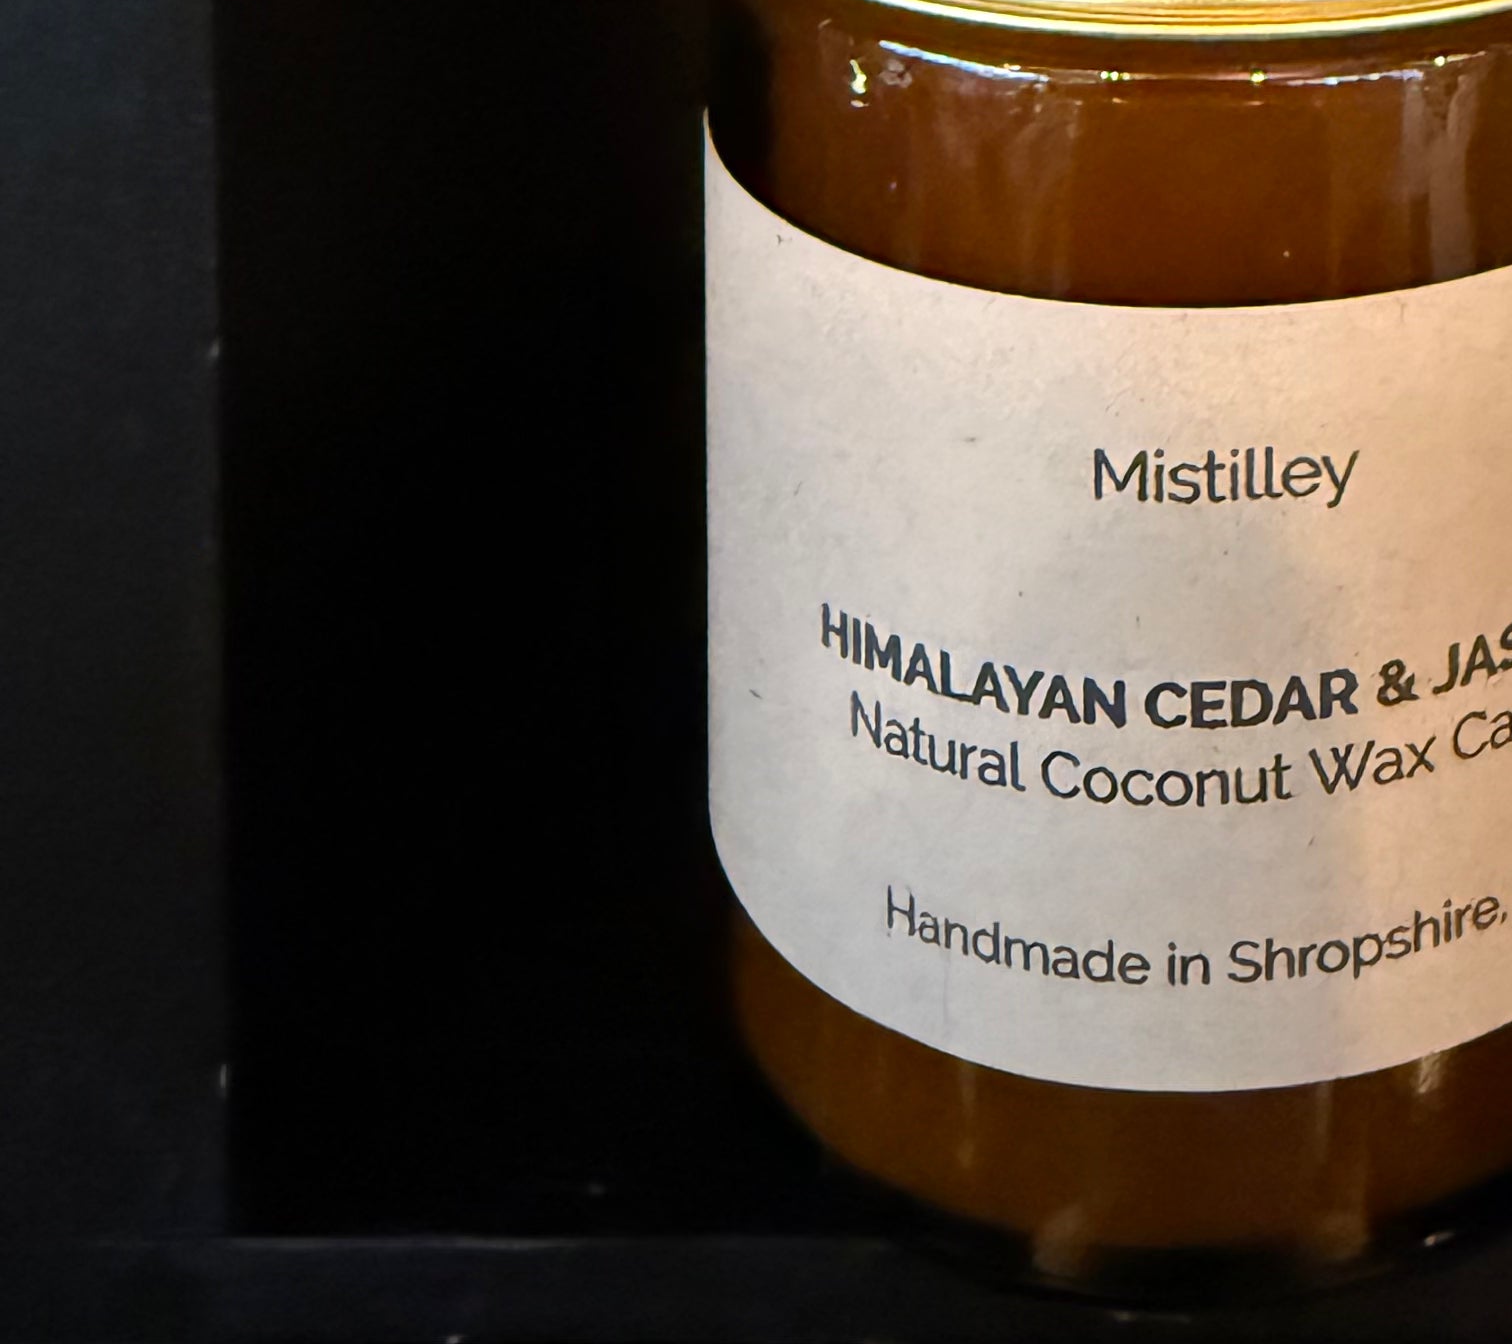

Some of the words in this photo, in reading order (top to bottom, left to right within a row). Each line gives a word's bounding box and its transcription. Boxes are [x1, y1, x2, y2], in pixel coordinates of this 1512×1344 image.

[1094, 446, 1360, 508] Mistilley
[821, 603, 1126, 728] HIMALAYAN
[1144, 669, 1359, 729] CEDAR
[1376, 659, 1419, 706] &
[851, 690, 1026, 791] Natural
[1041, 751, 1292, 806] Coconut
[1309, 735, 1436, 794] Wax
[887, 885, 1150, 984] Handmade
[1168, 942, 1210, 986] in
[1227, 896, 1507, 983] Shropshire,
